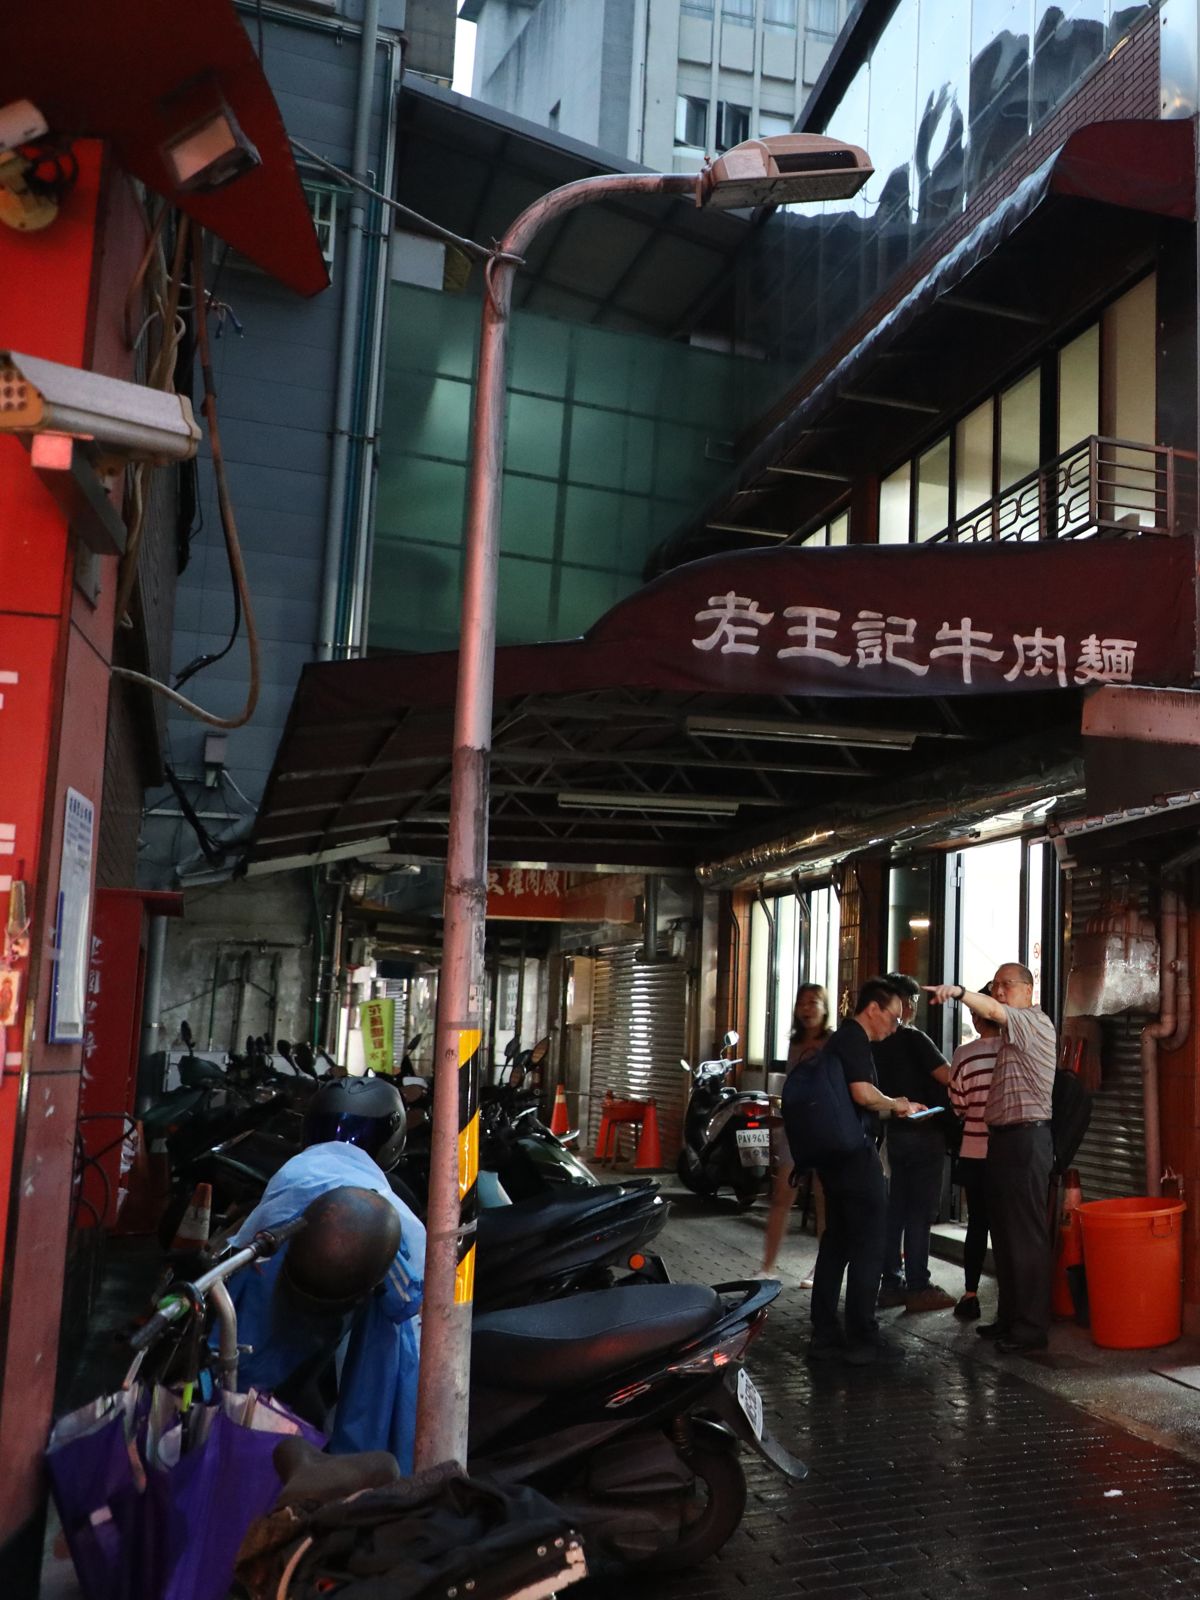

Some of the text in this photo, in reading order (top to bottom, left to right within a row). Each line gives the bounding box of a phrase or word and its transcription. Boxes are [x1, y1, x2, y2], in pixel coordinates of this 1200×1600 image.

[691, 590, 1138, 688] 老王記牛肉麵
